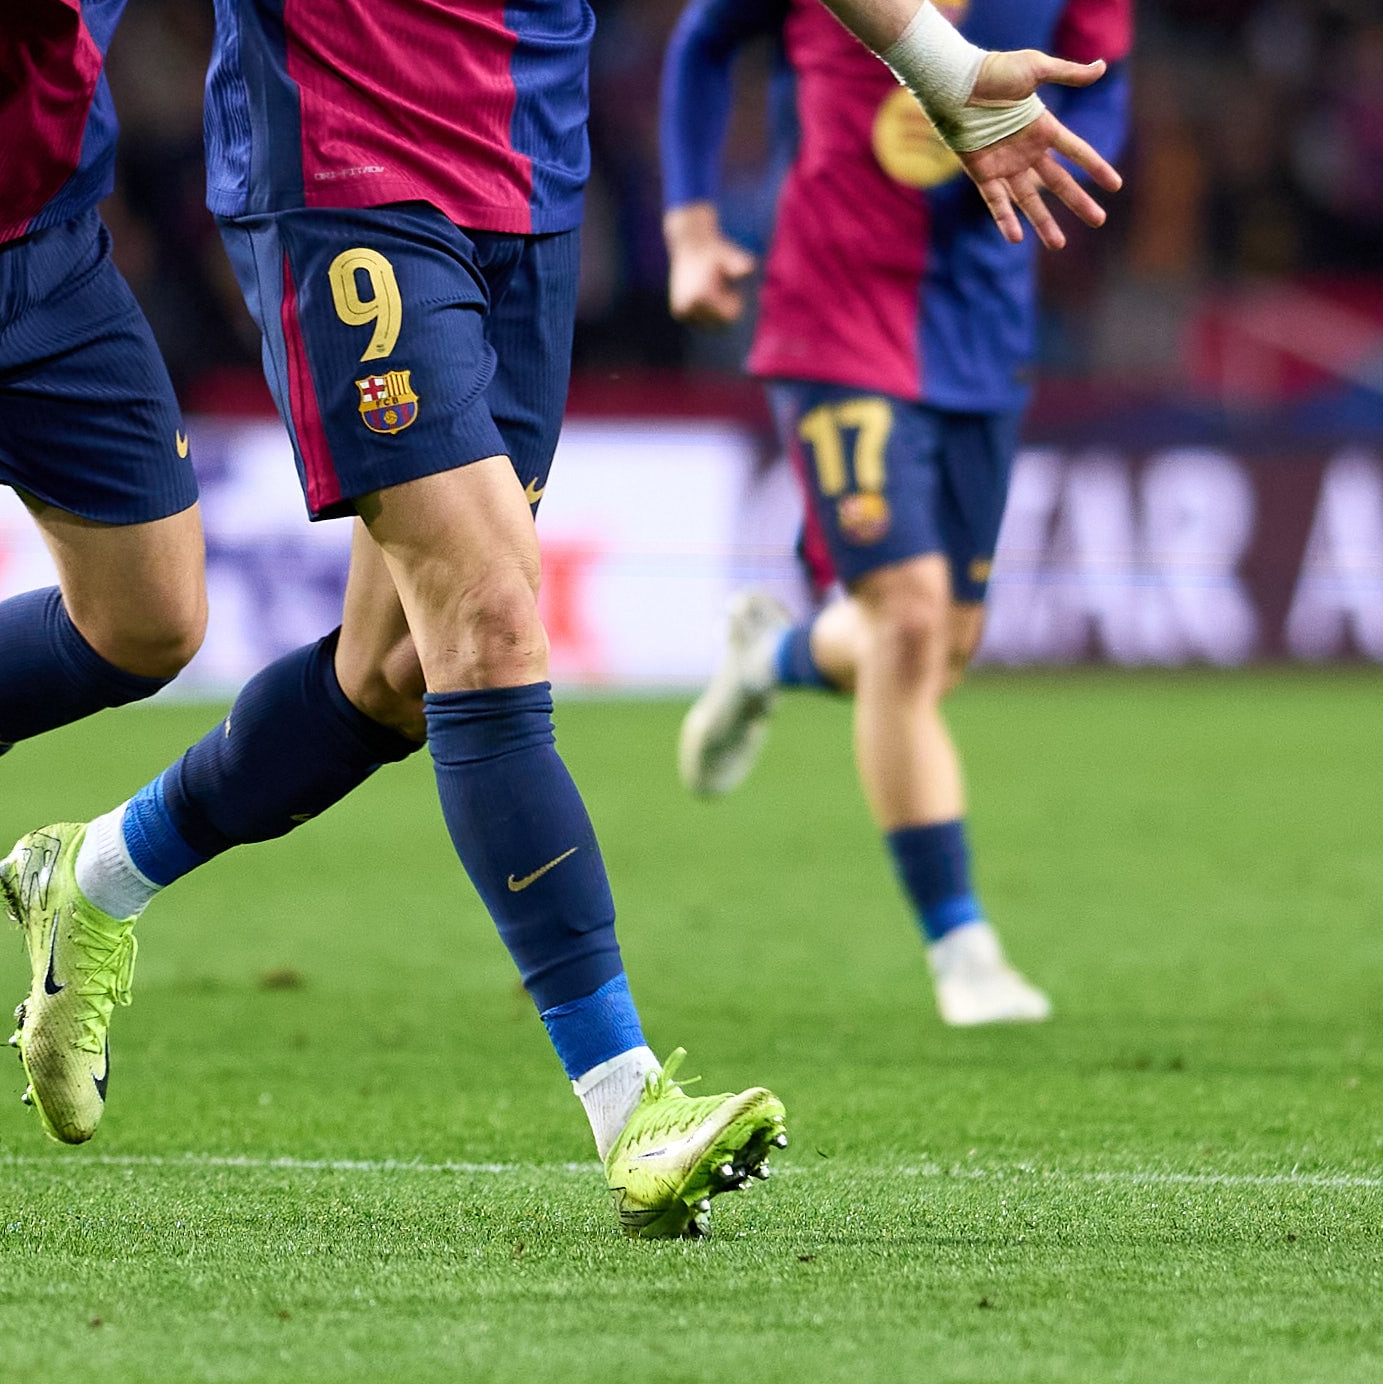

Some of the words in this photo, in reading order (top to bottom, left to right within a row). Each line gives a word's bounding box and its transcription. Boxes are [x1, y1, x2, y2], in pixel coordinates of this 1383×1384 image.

[328, 248, 402, 362] 9
[376, 396, 399, 407] FCB
[798, 398, 892, 497] 17
